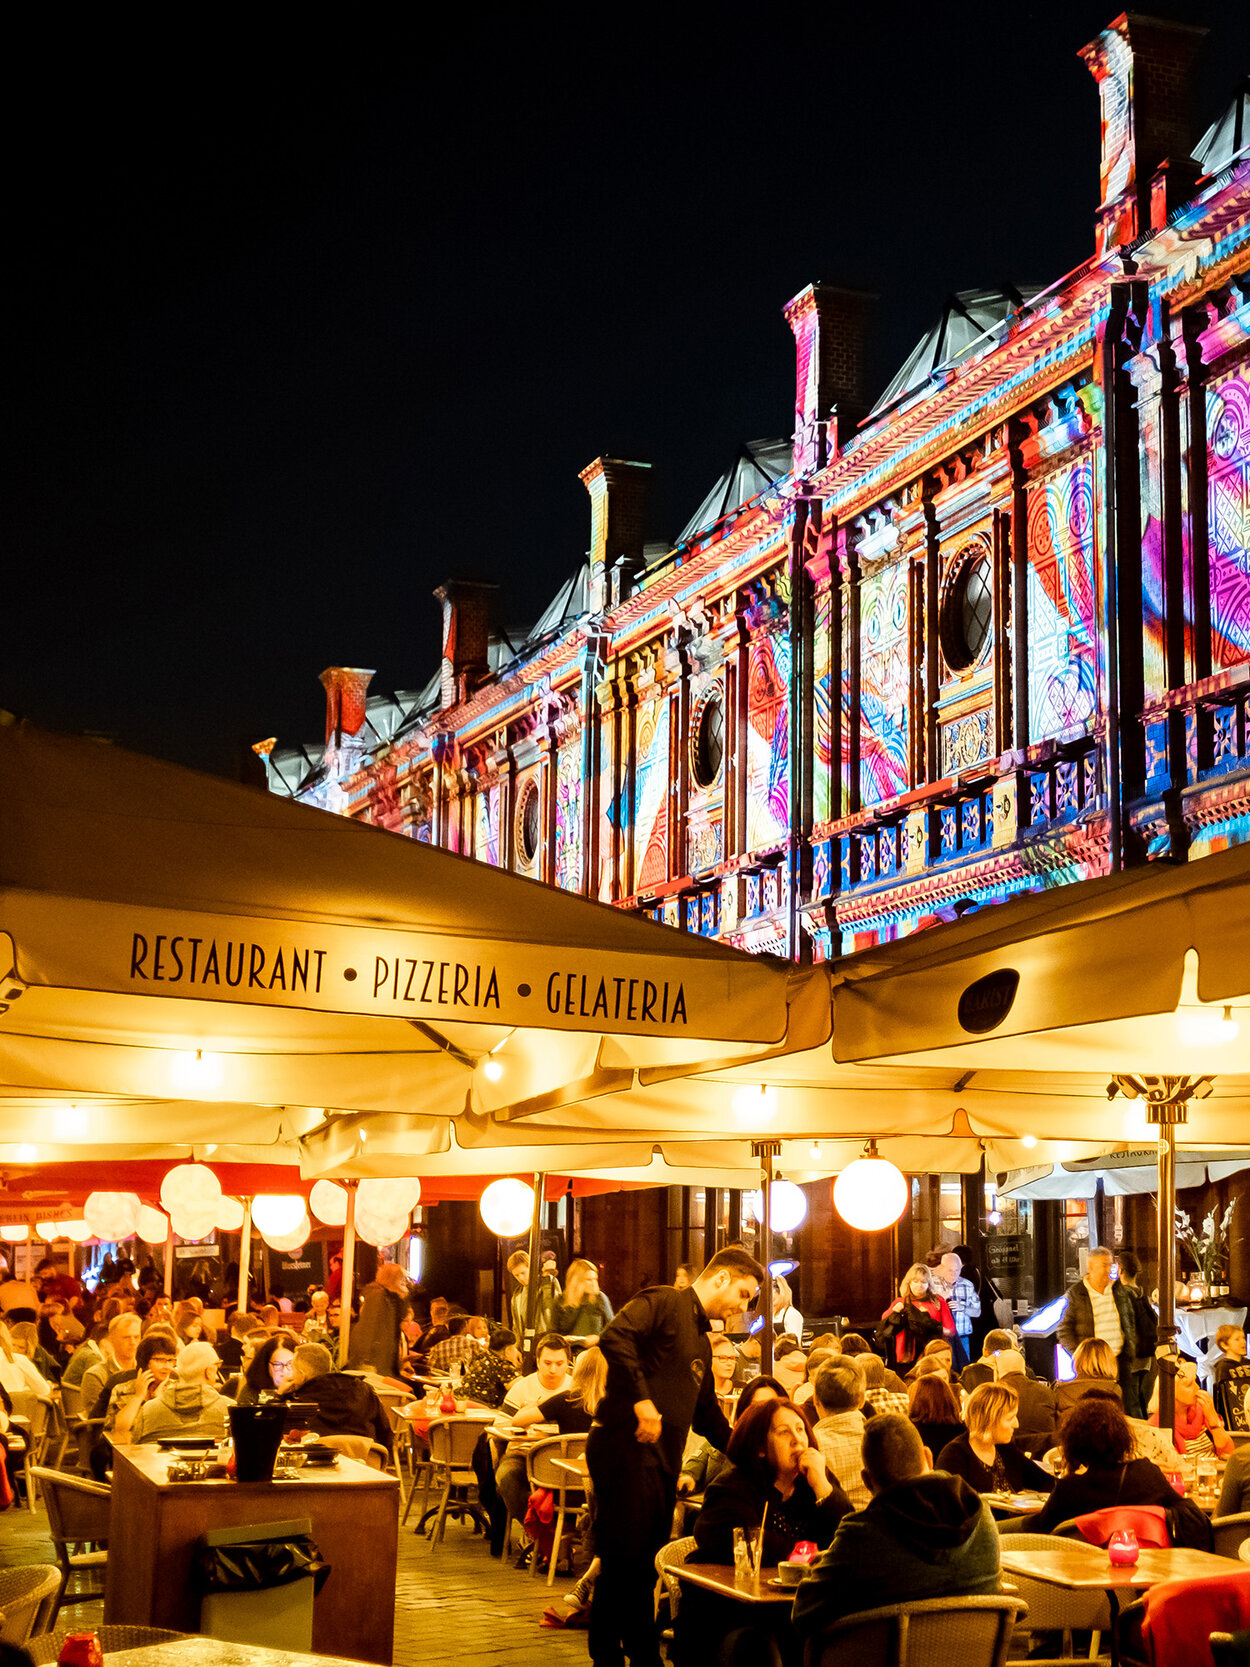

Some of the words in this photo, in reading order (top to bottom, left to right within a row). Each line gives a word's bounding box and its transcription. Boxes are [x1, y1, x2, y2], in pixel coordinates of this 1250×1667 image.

[129, 932, 327, 993] RESTAURANT
[373, 955, 501, 1009] PIZZERIA
[545, 971, 688, 1025] GELATERIA
